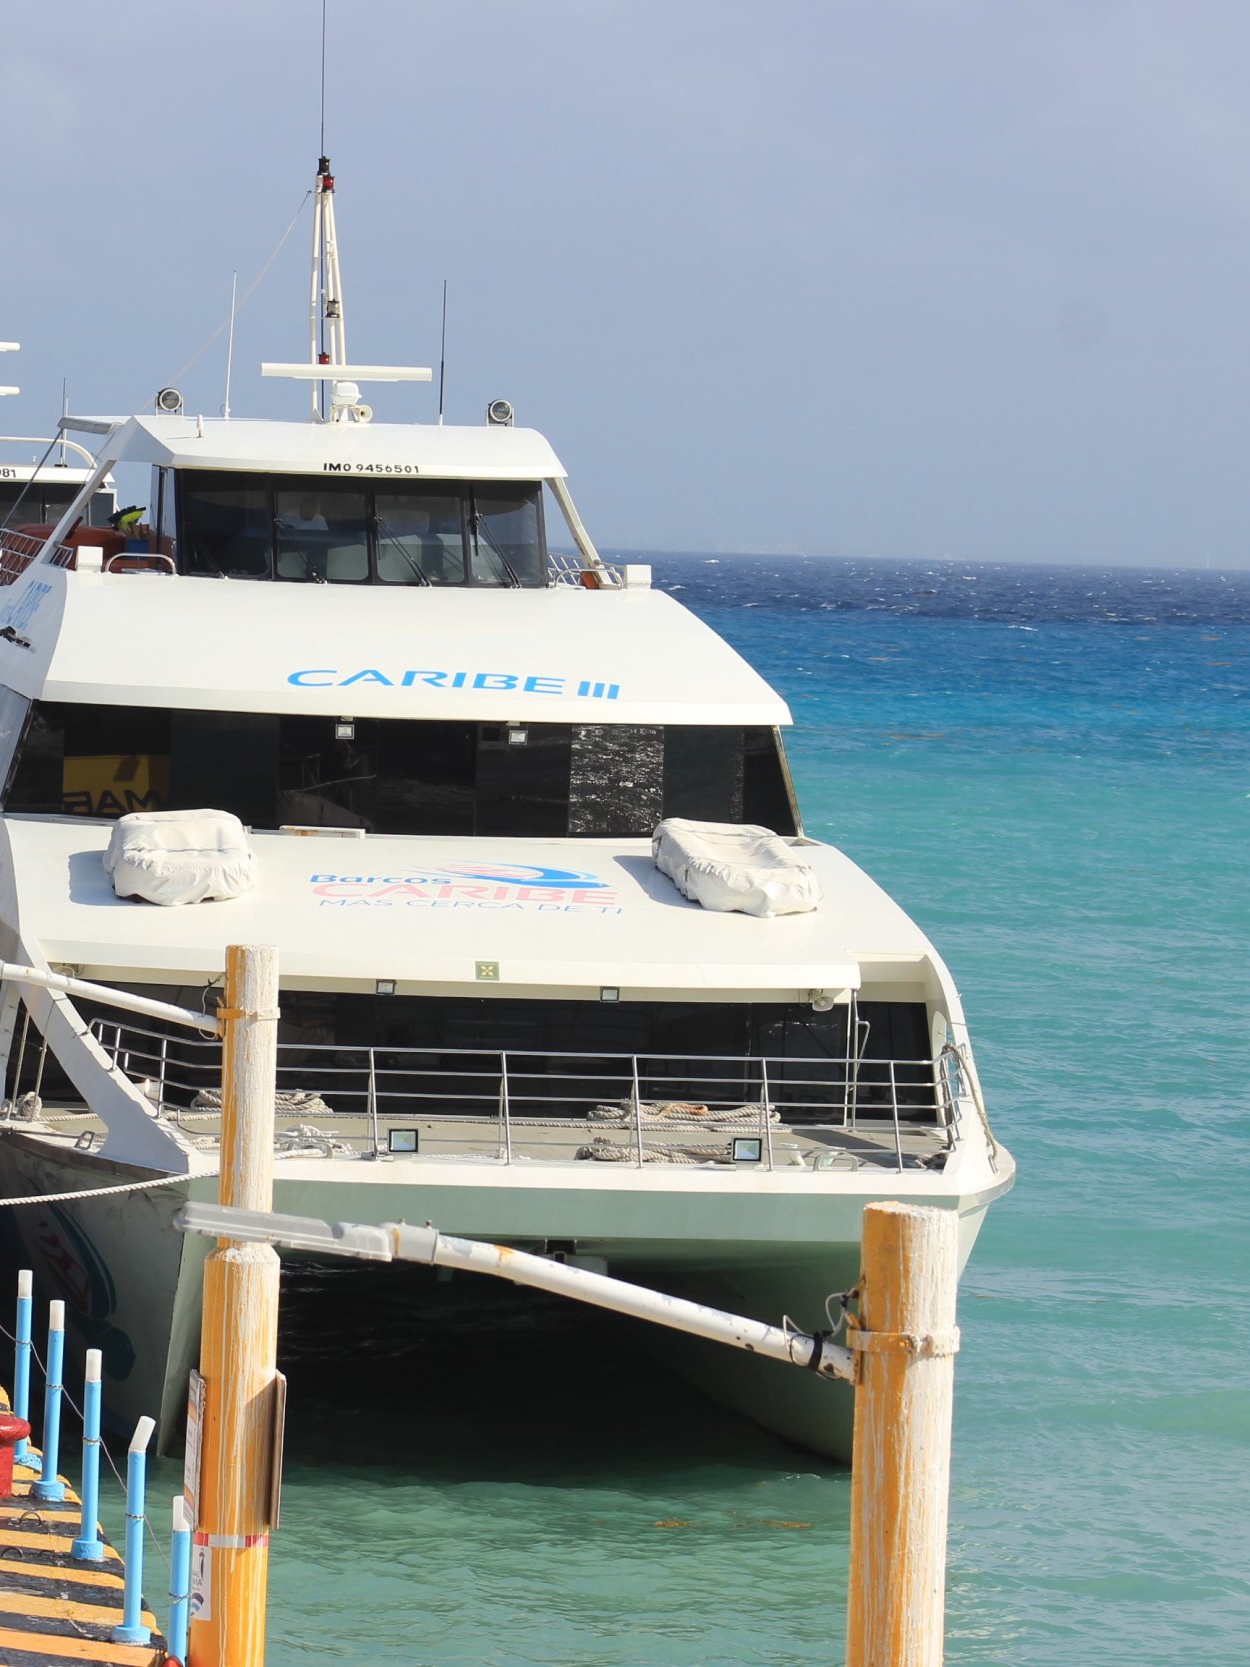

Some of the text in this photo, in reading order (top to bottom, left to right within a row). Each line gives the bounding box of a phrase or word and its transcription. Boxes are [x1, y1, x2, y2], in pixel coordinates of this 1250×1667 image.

[323, 462, 419, 474] IMO 9456501
[287, 670, 620, 700] CARIBE III
[309, 874, 451, 885] Barcos
[313, 884, 618, 906] CARIBE
[319, 898, 623, 914] MAS CERCA DE TI
